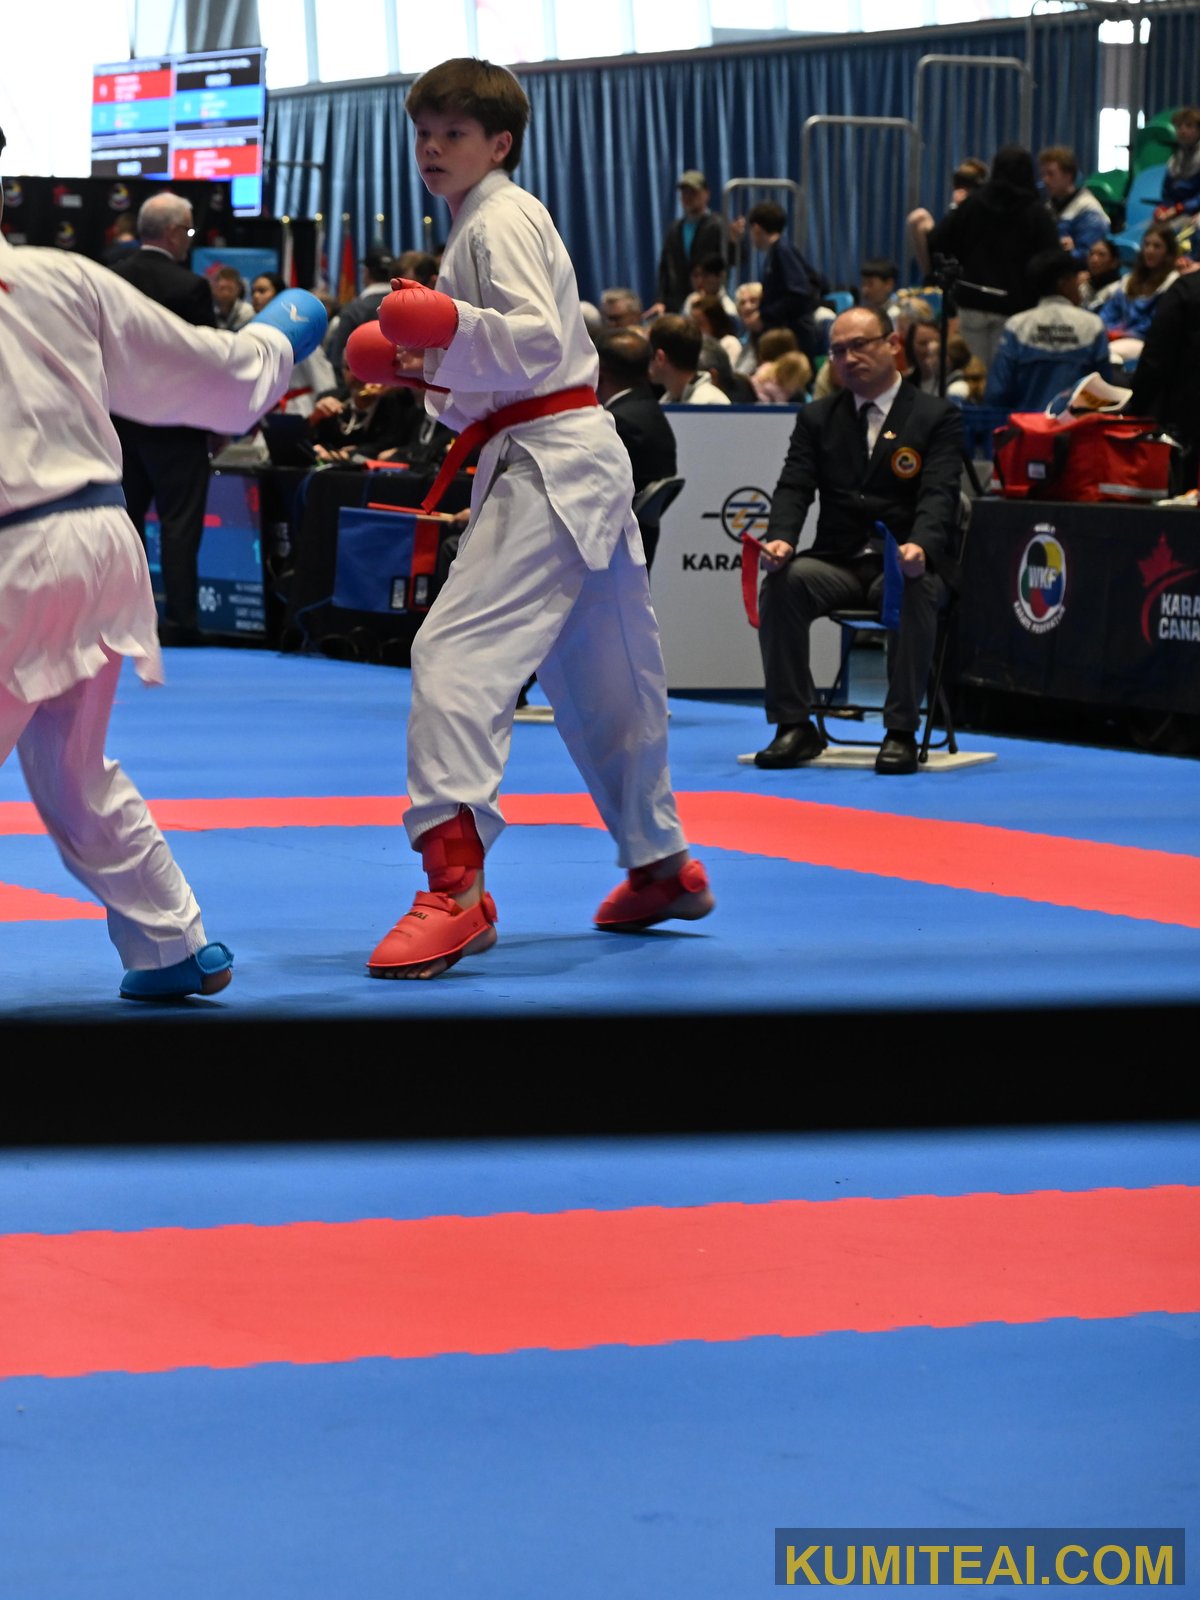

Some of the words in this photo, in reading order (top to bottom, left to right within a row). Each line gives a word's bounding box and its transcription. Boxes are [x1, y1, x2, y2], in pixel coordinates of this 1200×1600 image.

[682, 553, 766, 571] KARA
[1028, 565, 1057, 590] WKF
[1161, 593, 1200, 617] KARA
[1159, 617, 1200, 642] CANA
